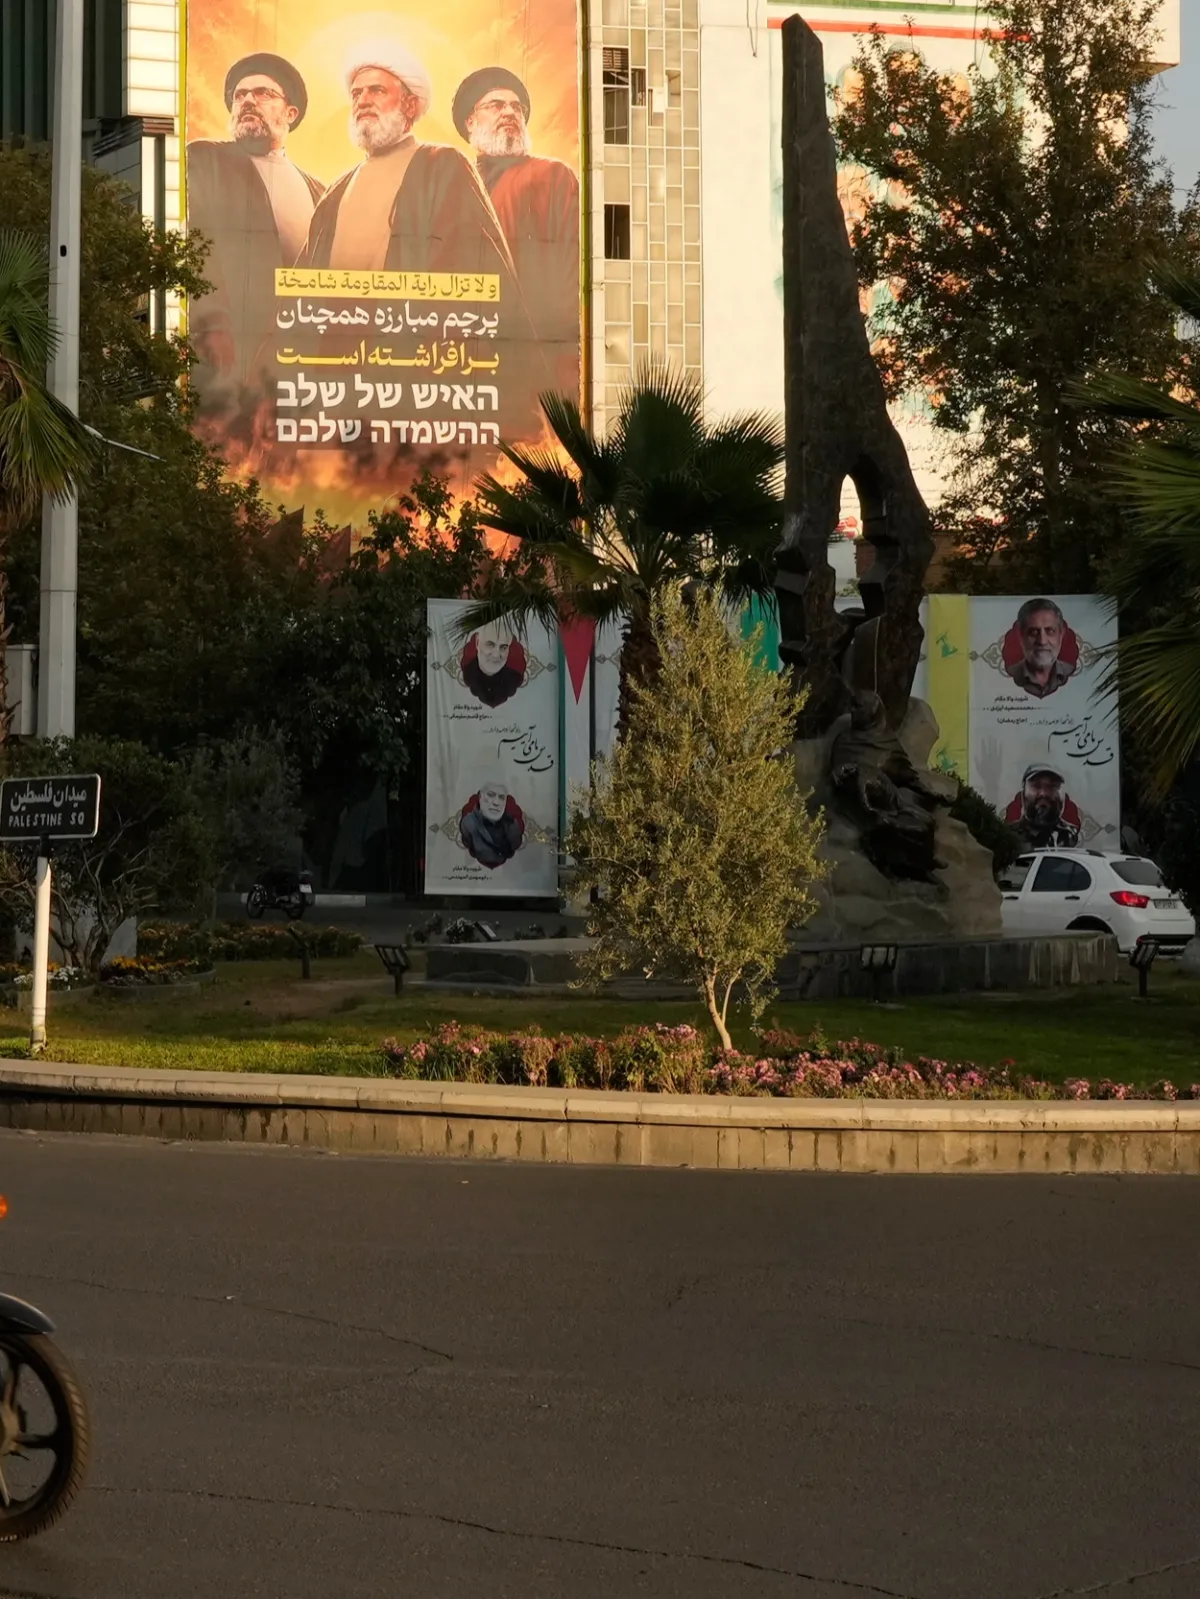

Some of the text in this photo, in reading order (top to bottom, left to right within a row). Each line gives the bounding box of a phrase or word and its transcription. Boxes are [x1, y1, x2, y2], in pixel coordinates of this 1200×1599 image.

[278, 271, 497, 298] و لا تزال راية المقاومة شامخة
[276, 297, 499, 339] پرچم مبارزه همچنان
[276, 340, 366, 368] است
[276, 372, 499, 411] האיש של שלב
[276, 411, 500, 445] ההשמדה שלכם
[10, 780, 87, 812] میدان فلسطین
[8, 813, 63, 827] PALESTINE
